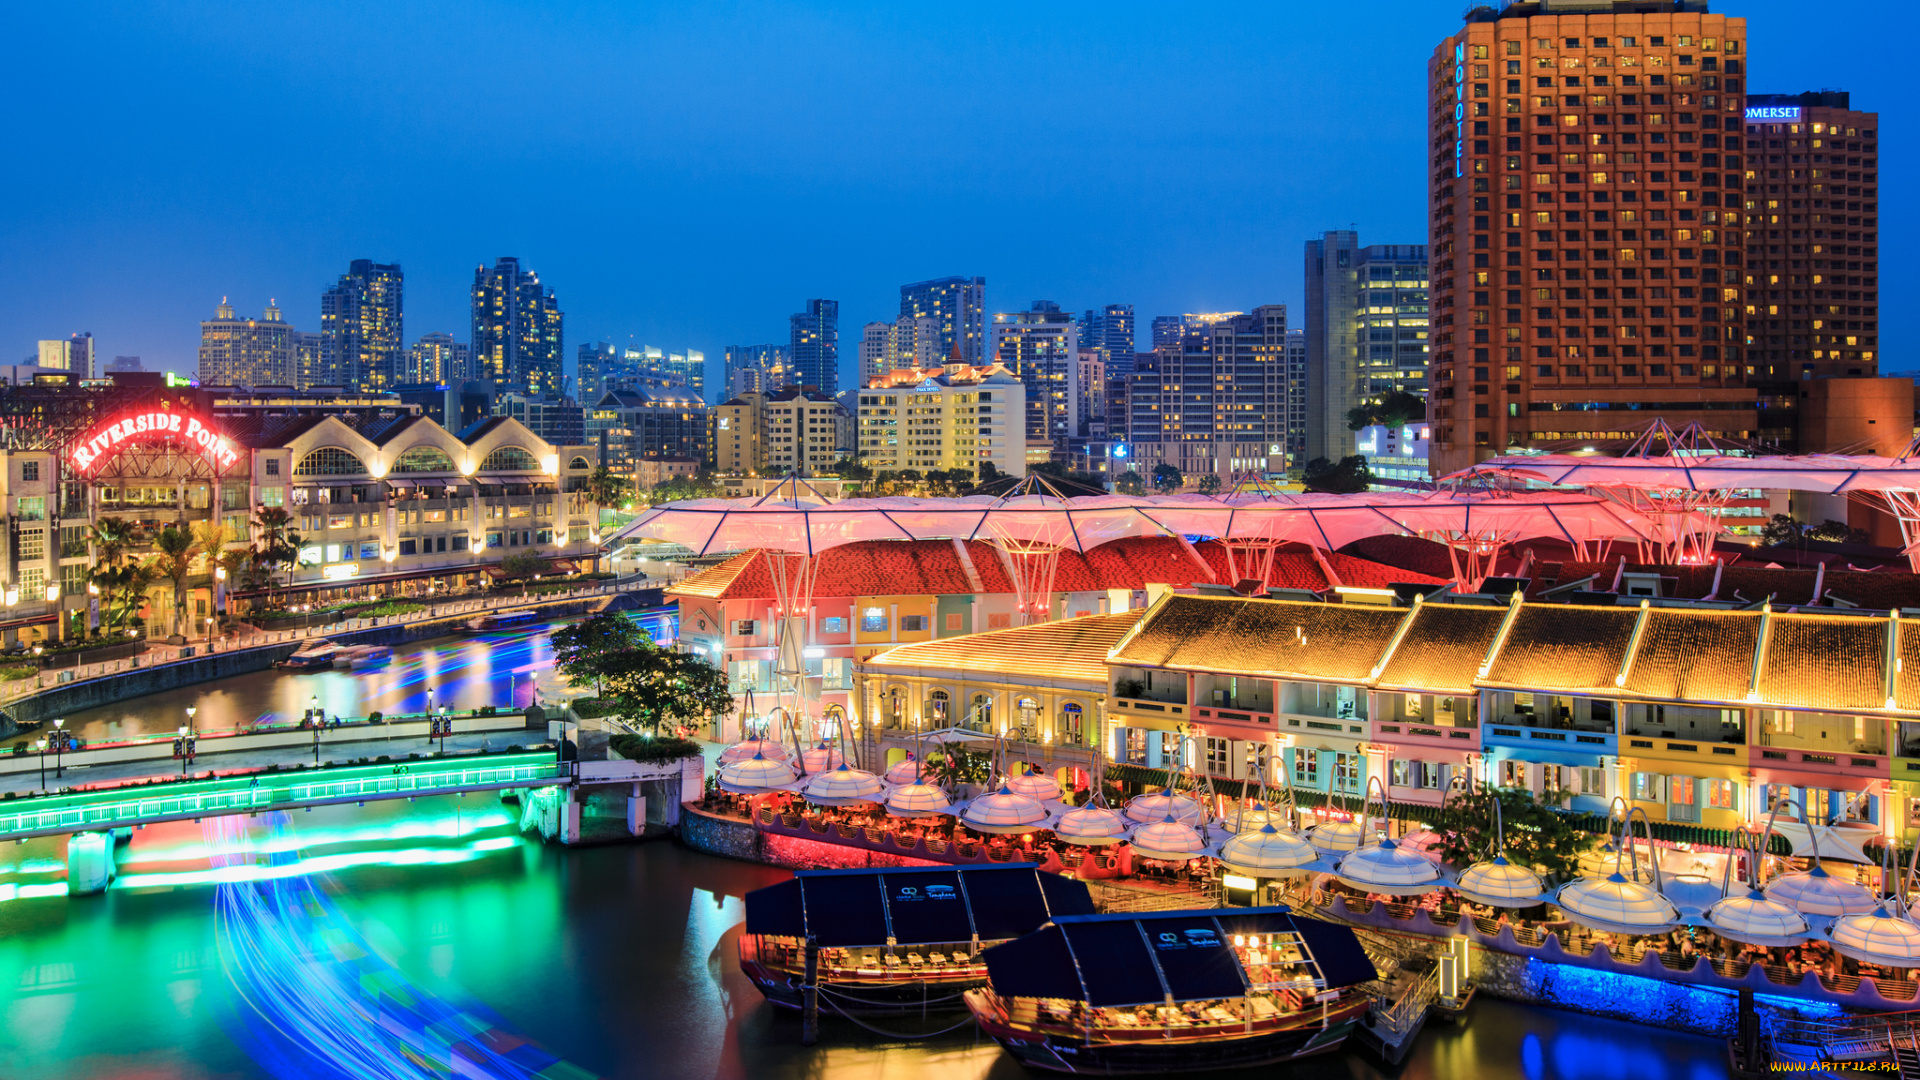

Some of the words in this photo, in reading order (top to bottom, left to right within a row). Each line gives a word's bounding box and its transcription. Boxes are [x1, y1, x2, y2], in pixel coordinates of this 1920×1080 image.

[1455, 41, 1464, 178] NOVOTEL
[73, 413, 181, 470] RIVERSIDE
[185, 417, 237, 466] POINT
